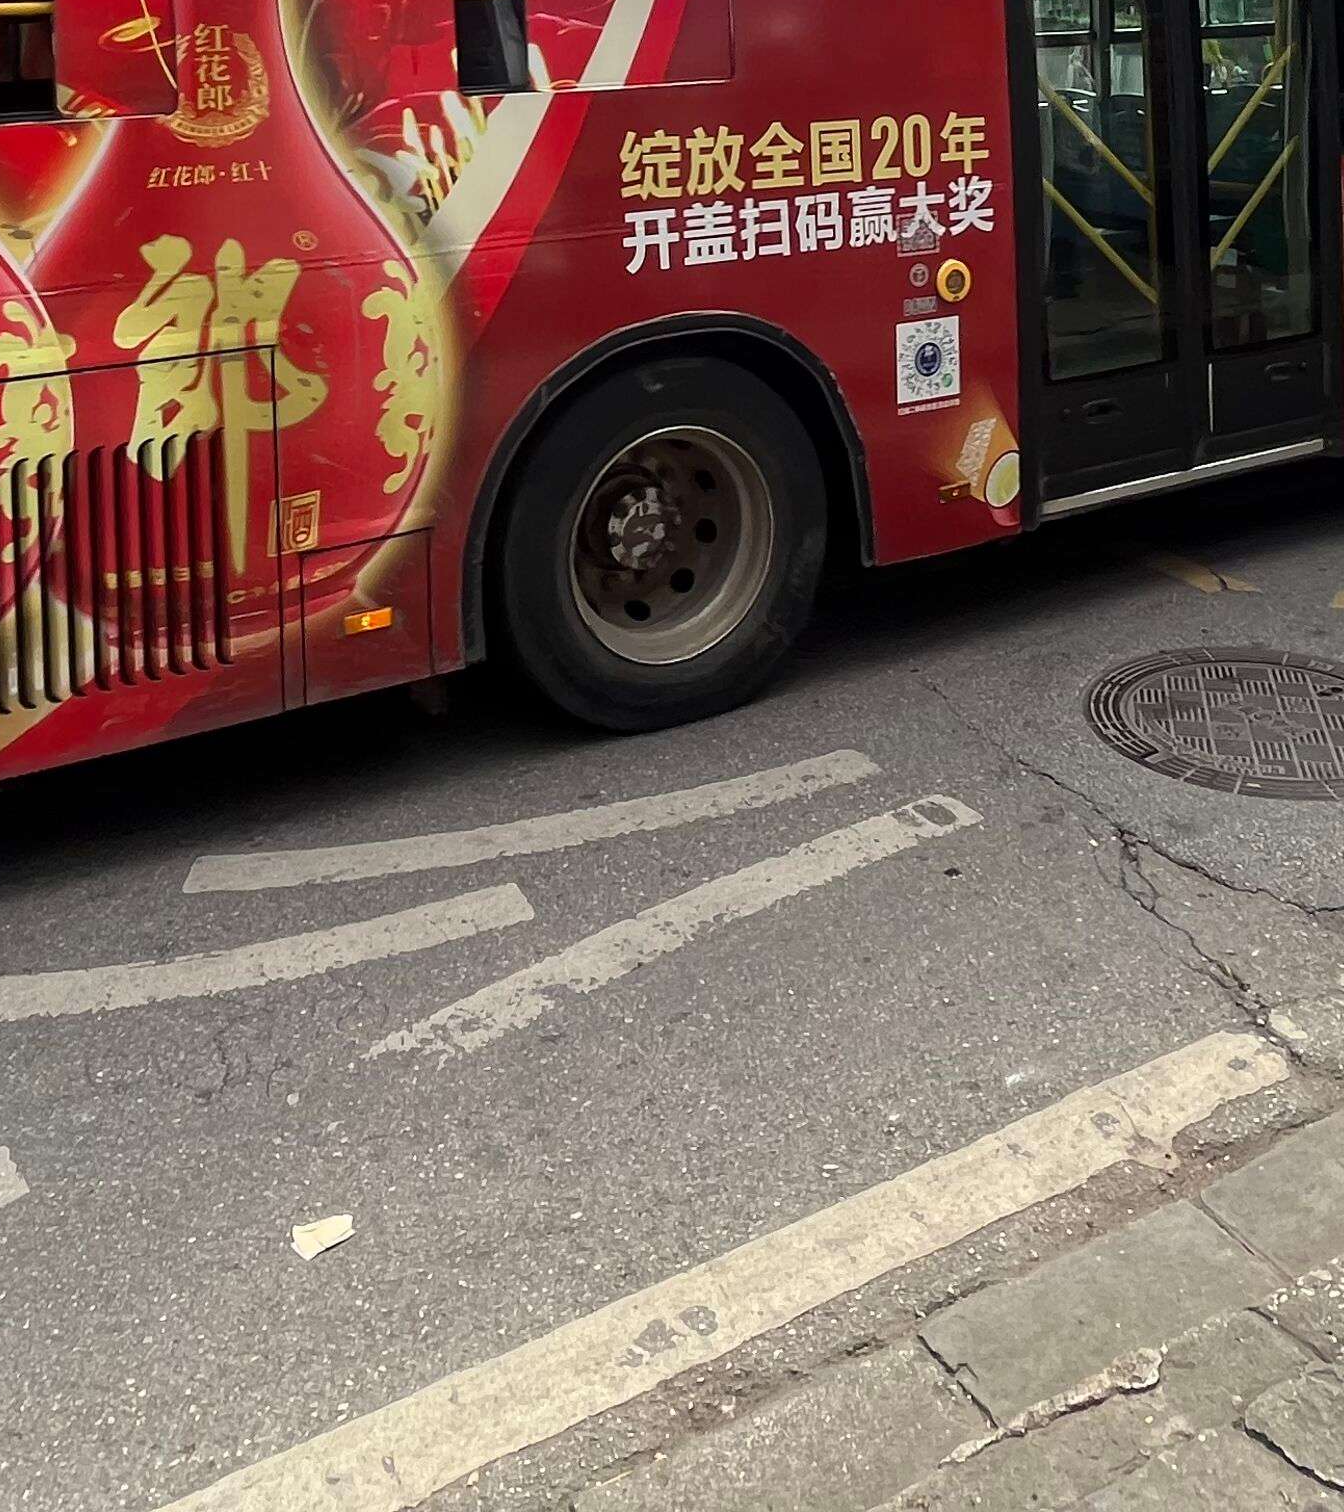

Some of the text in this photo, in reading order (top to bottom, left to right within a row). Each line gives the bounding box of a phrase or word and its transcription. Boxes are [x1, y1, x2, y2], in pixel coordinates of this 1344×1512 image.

[193, 23, 233, 111] 红花郎
[618, 111, 991, 202] 绽放全国20年
[621, 175, 996, 275] 开盖扫码赢大奖
